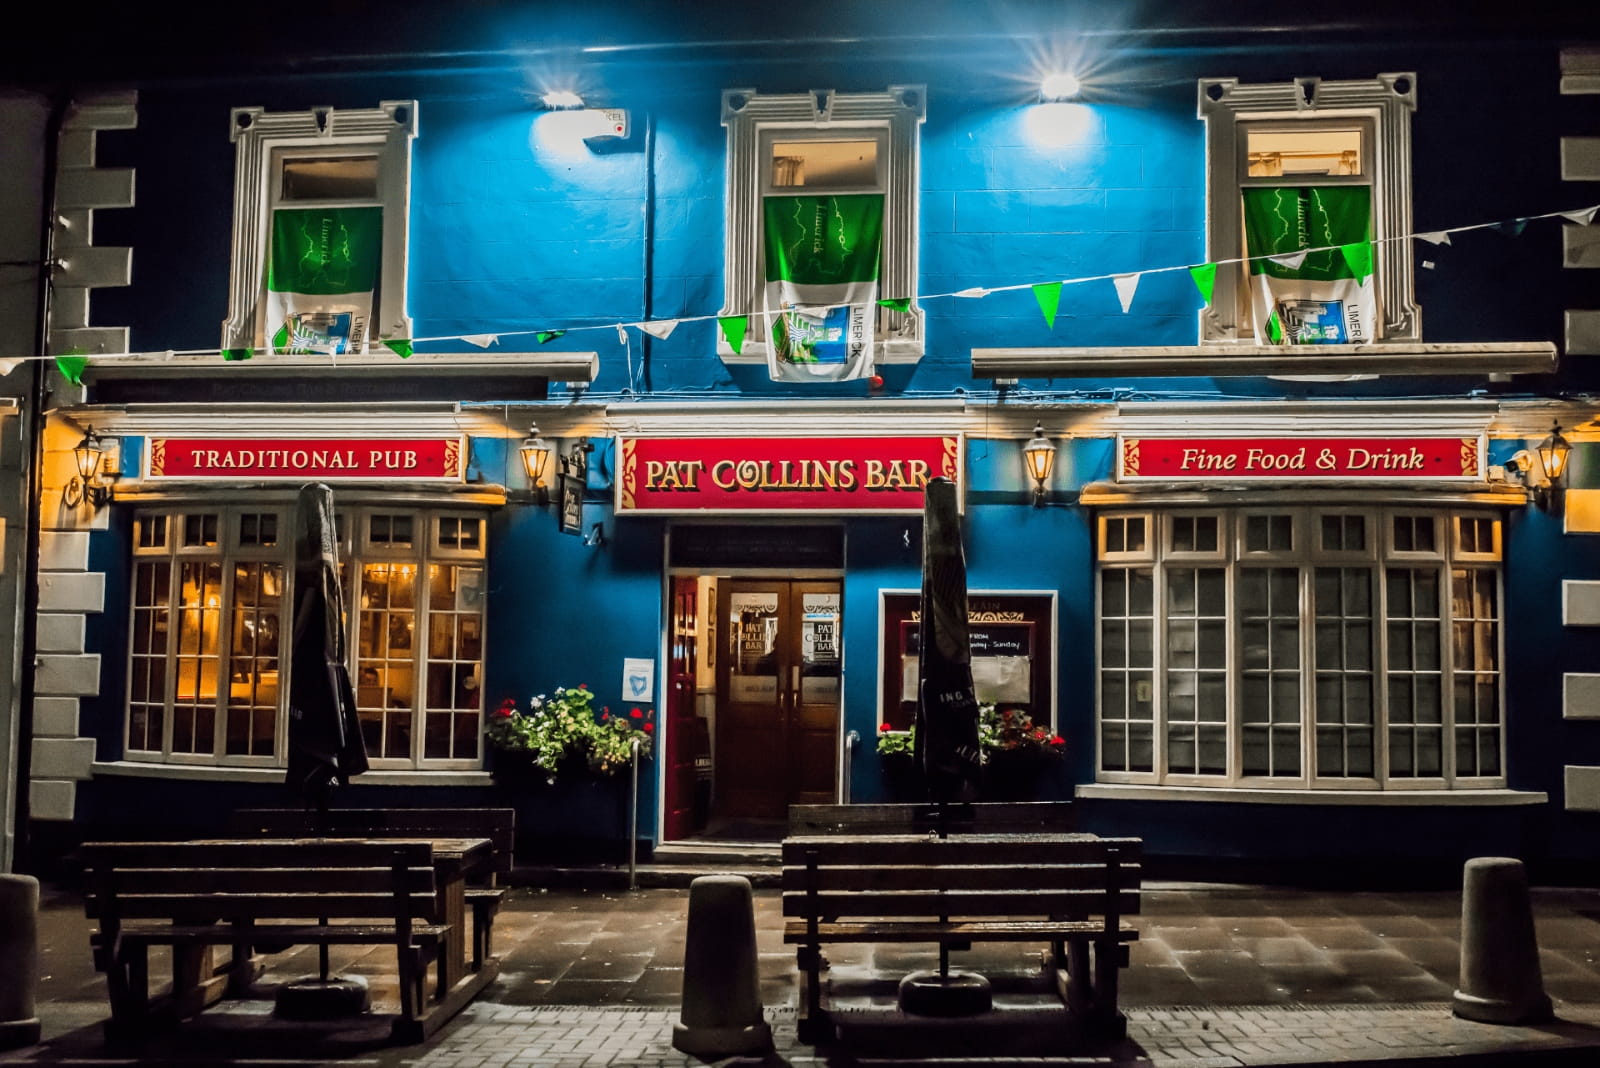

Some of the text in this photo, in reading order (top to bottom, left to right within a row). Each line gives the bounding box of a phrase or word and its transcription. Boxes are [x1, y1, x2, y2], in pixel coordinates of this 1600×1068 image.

[814, 204, 827, 254] Limerick
[1297, 197, 1310, 247] Limerick
[851, 307, 864, 358] LIMERICK
[1348, 304, 1362, 344] LIMERIC
[191, 450, 418, 469] TRADITIONAL PUB
[1180, 446, 1424, 470] Fine Food & Drink
[645, 459, 930, 491] PAT COLLINS BAR
[817, 624, 833, 634] PAT
[745, 641, 762, 650] BAR
[817, 642, 835, 651] BAR
[993, 641, 1020, 650] Sunday
